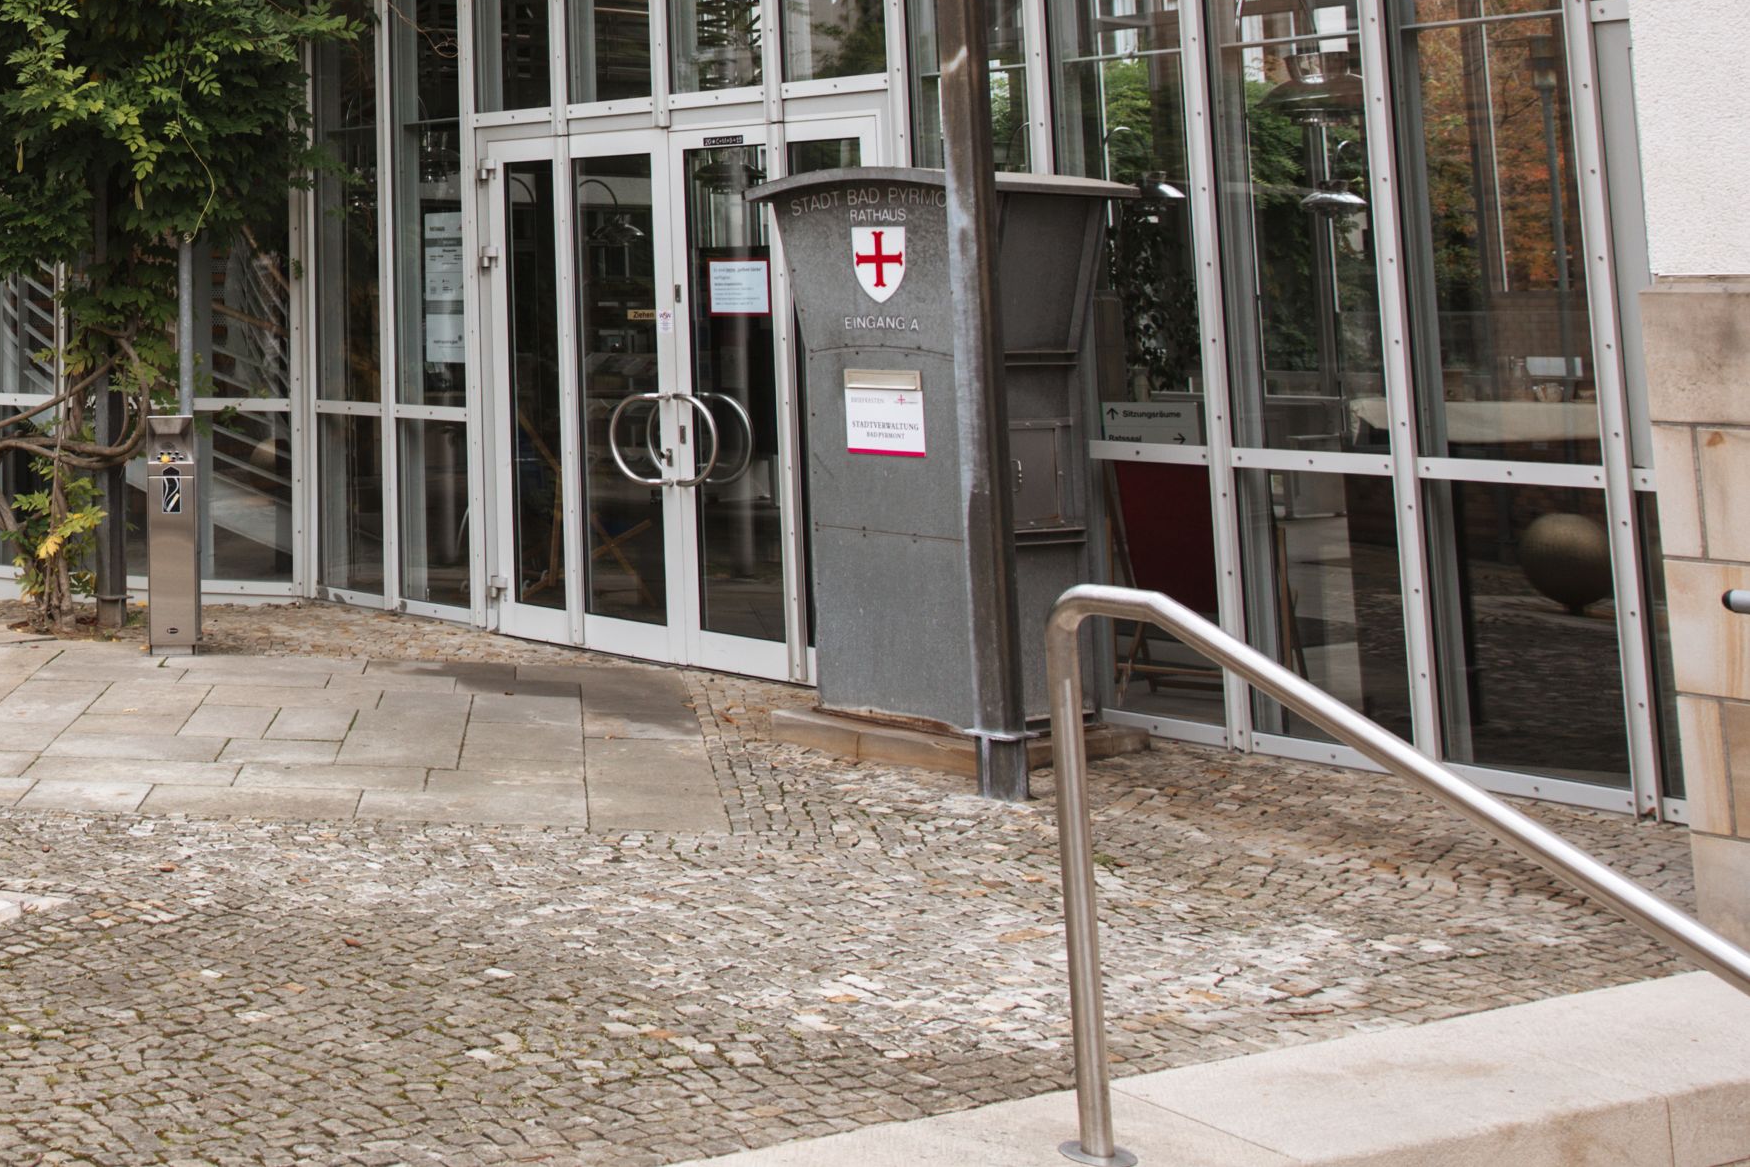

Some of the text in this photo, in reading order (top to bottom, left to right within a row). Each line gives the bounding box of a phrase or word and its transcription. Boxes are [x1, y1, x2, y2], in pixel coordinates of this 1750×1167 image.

[790, 187, 947, 217] STADT BAD PYRMO
[849, 208, 907, 222] RATHAUS
[633, 311, 655, 319] Ziehen
[844, 315, 919, 331] EINGANG A
[1122, 409, 1182, 419] Sitzungsräume
[852, 420, 919, 431] STADTVERWALTUNG
[878, 432, 905, 440] PYRMONT
